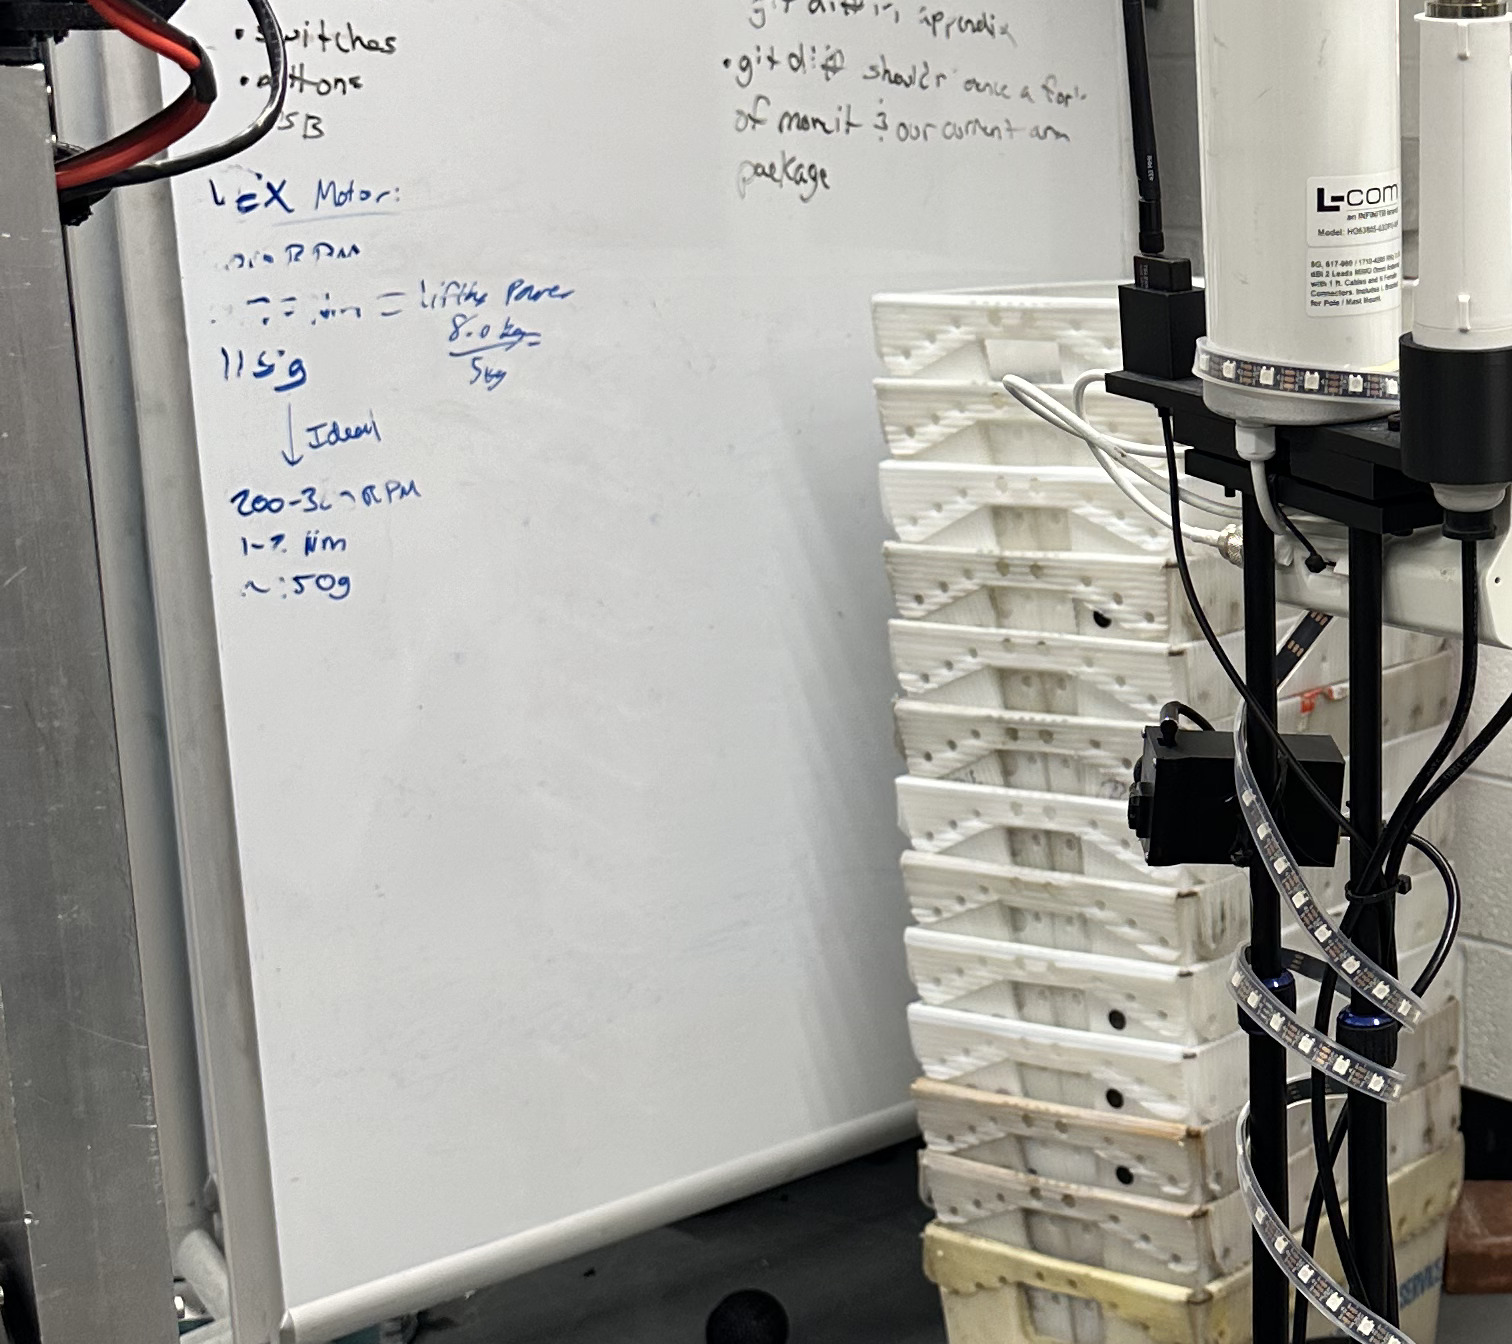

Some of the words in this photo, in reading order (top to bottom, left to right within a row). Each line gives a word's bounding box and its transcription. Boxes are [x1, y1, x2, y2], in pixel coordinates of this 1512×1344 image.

[734, 44, 780, 88] git
[895, 119, 939, 144] our
[1316, 183, 1399, 213] L-com
[1317, 227, 1344, 237] Model:
